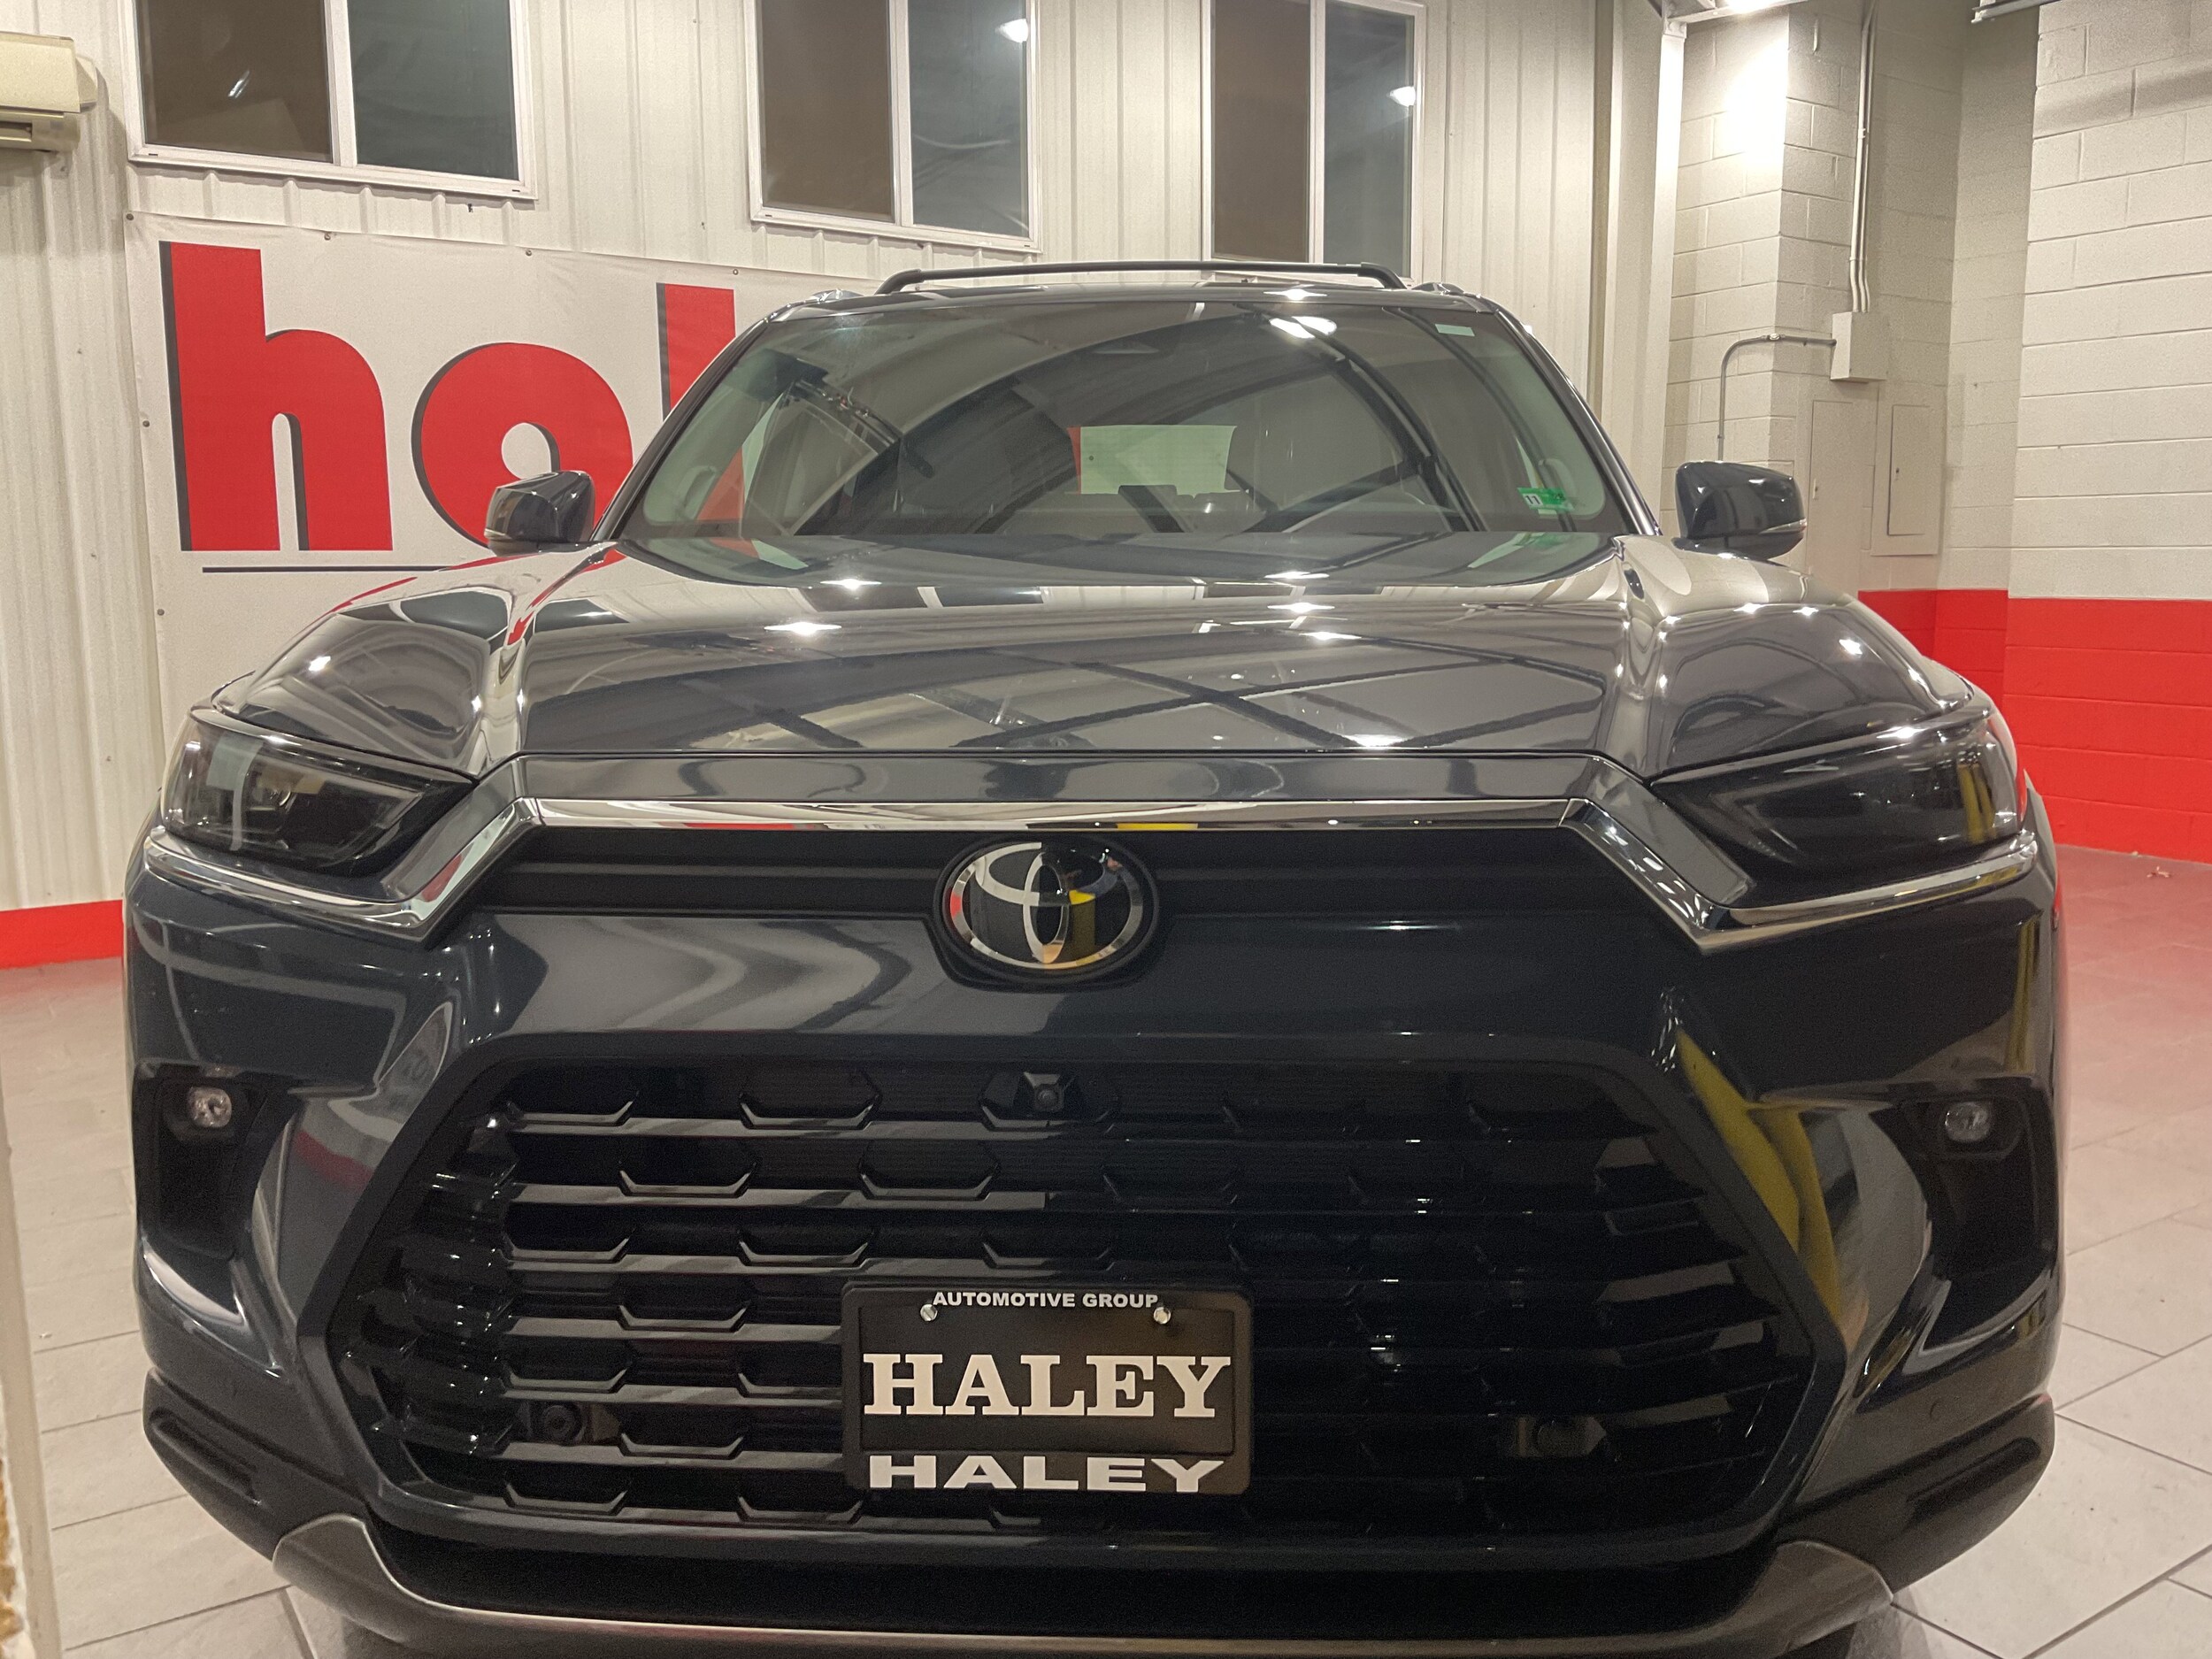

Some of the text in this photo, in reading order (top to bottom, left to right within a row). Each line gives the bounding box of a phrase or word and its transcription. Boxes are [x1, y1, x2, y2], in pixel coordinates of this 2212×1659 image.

[933, 1291, 1159, 1309] AUTOMOTIVE GROUP
[863, 1353, 1231, 1417] HALEY
[869, 1455, 1224, 1493] HALEY
